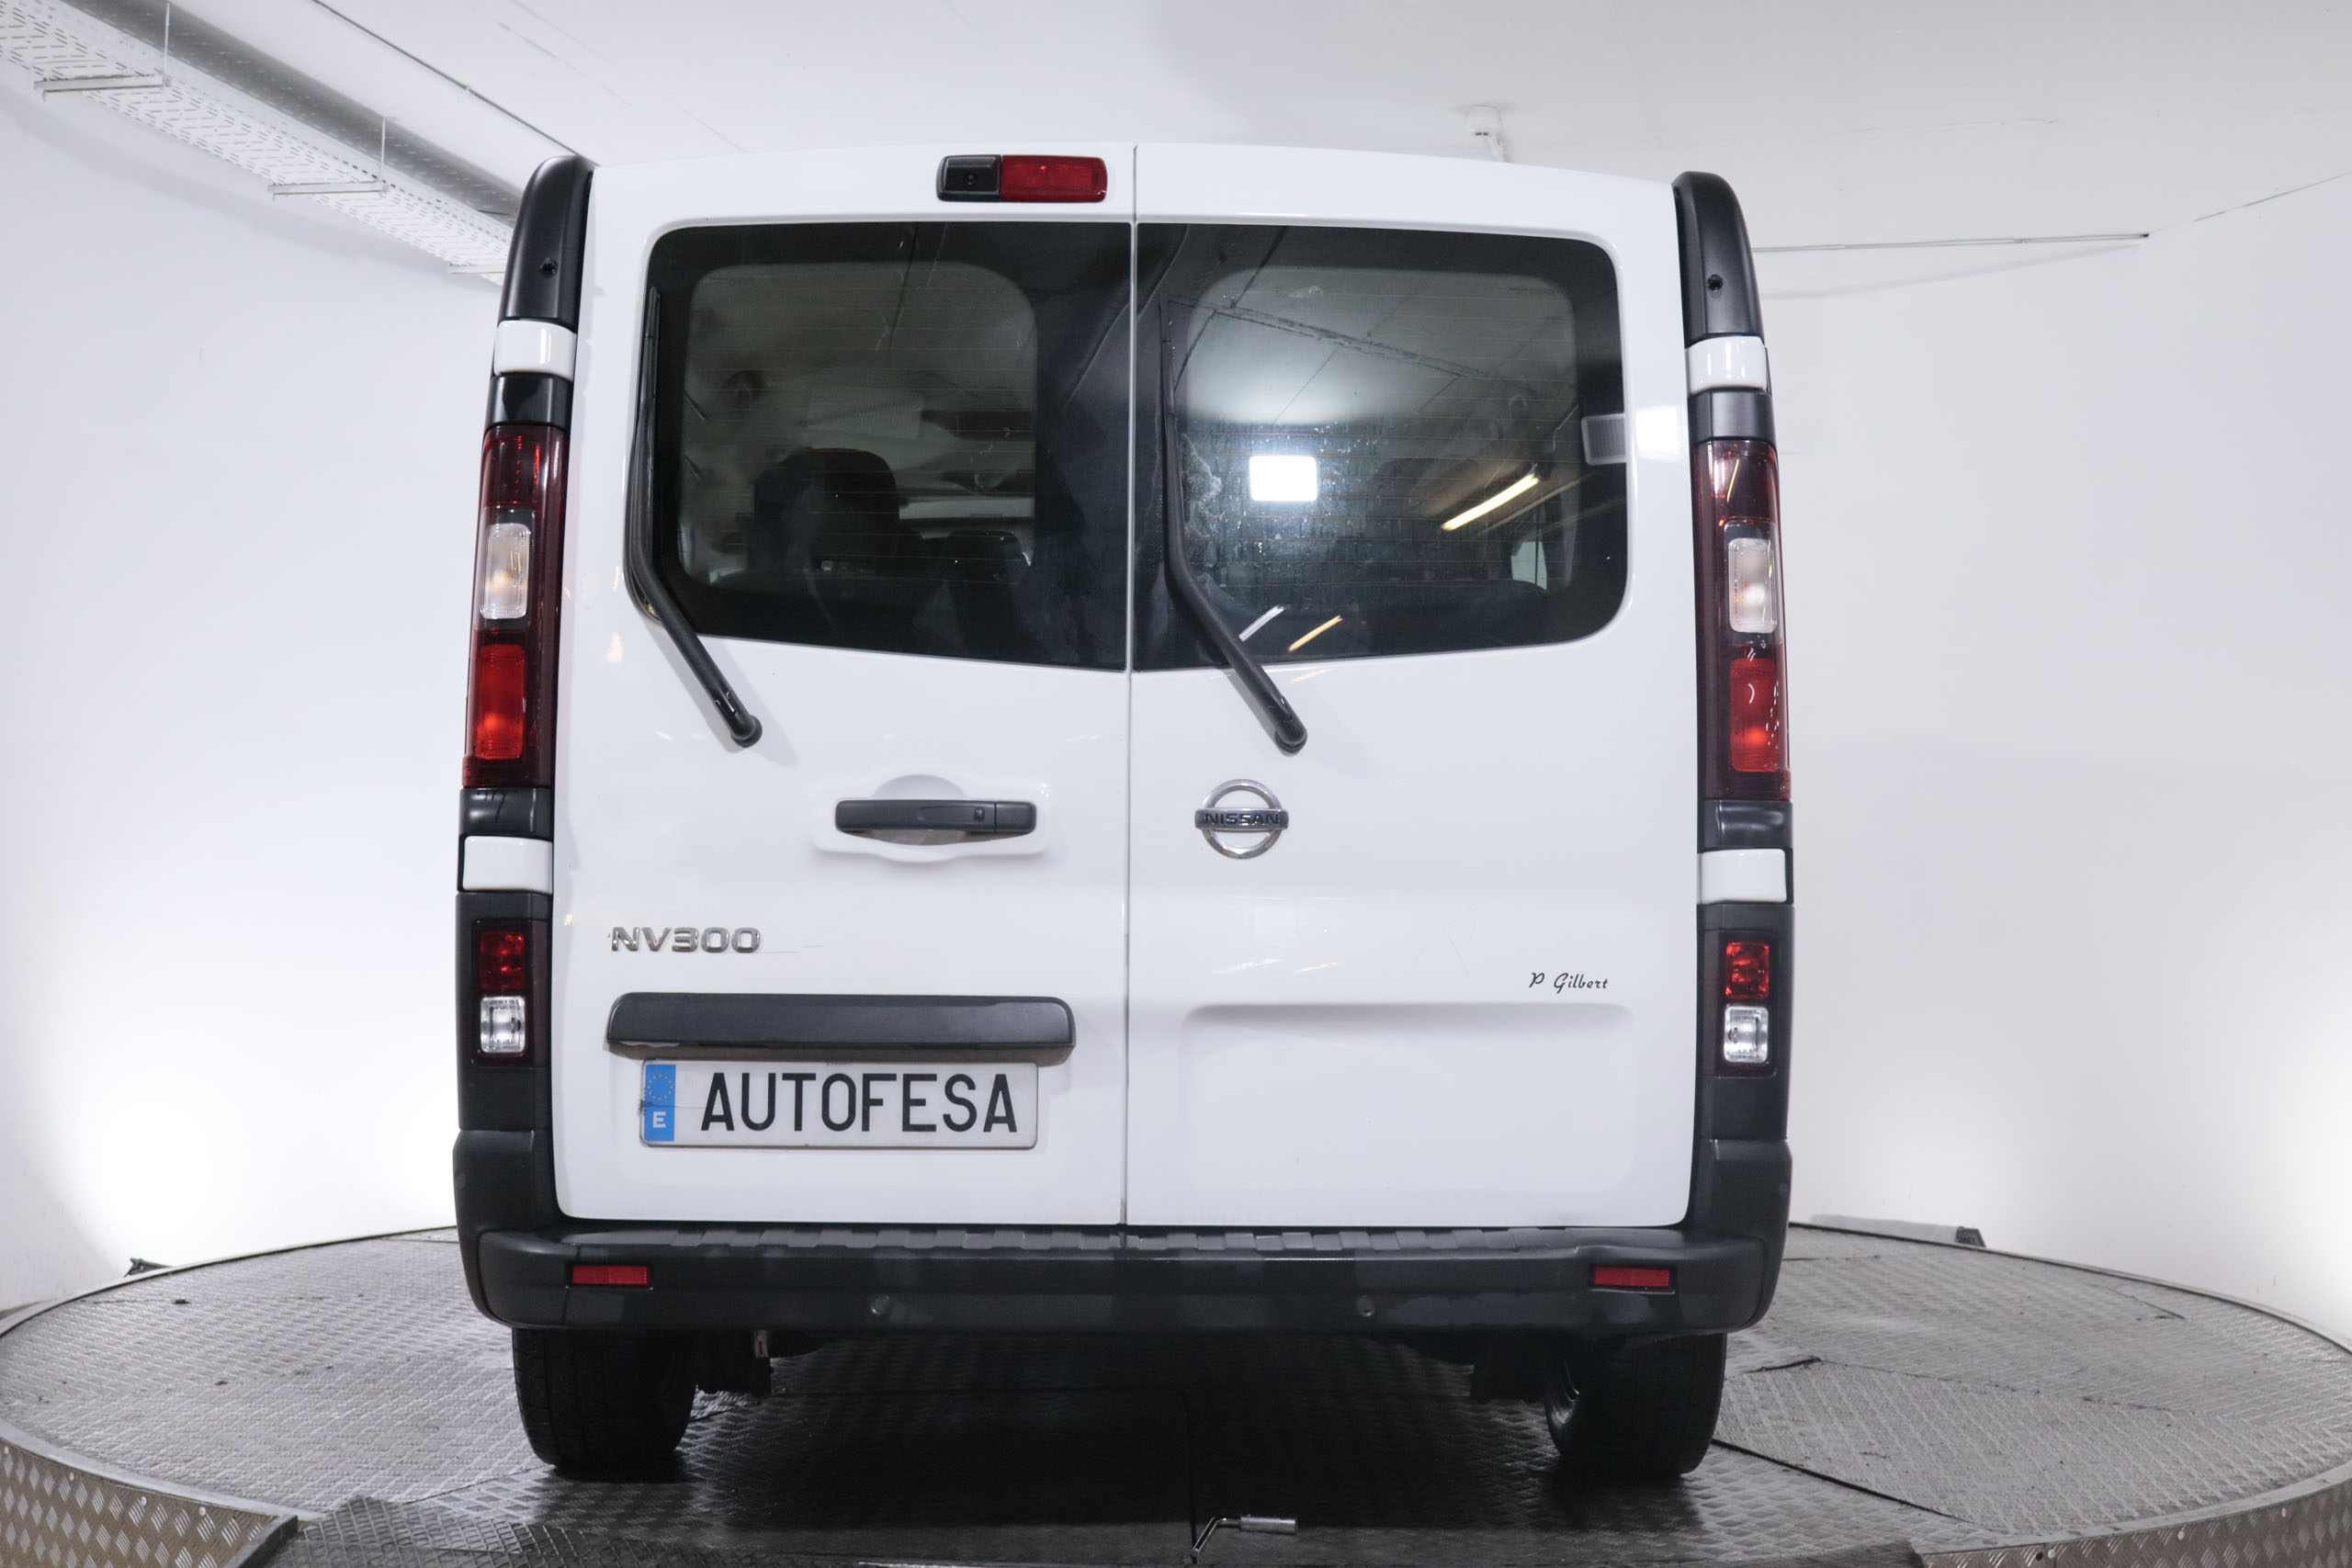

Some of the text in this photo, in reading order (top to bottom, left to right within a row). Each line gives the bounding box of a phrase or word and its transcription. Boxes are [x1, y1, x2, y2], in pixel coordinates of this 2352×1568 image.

[1204, 812, 1278, 826] NISSAN
[610, 926, 761, 953] NV300
[1529, 972, 1608, 994] P Gilbert
[701, 1072, 1018, 1133] AUTOFESA
[652, 1111, 666, 1128] E
